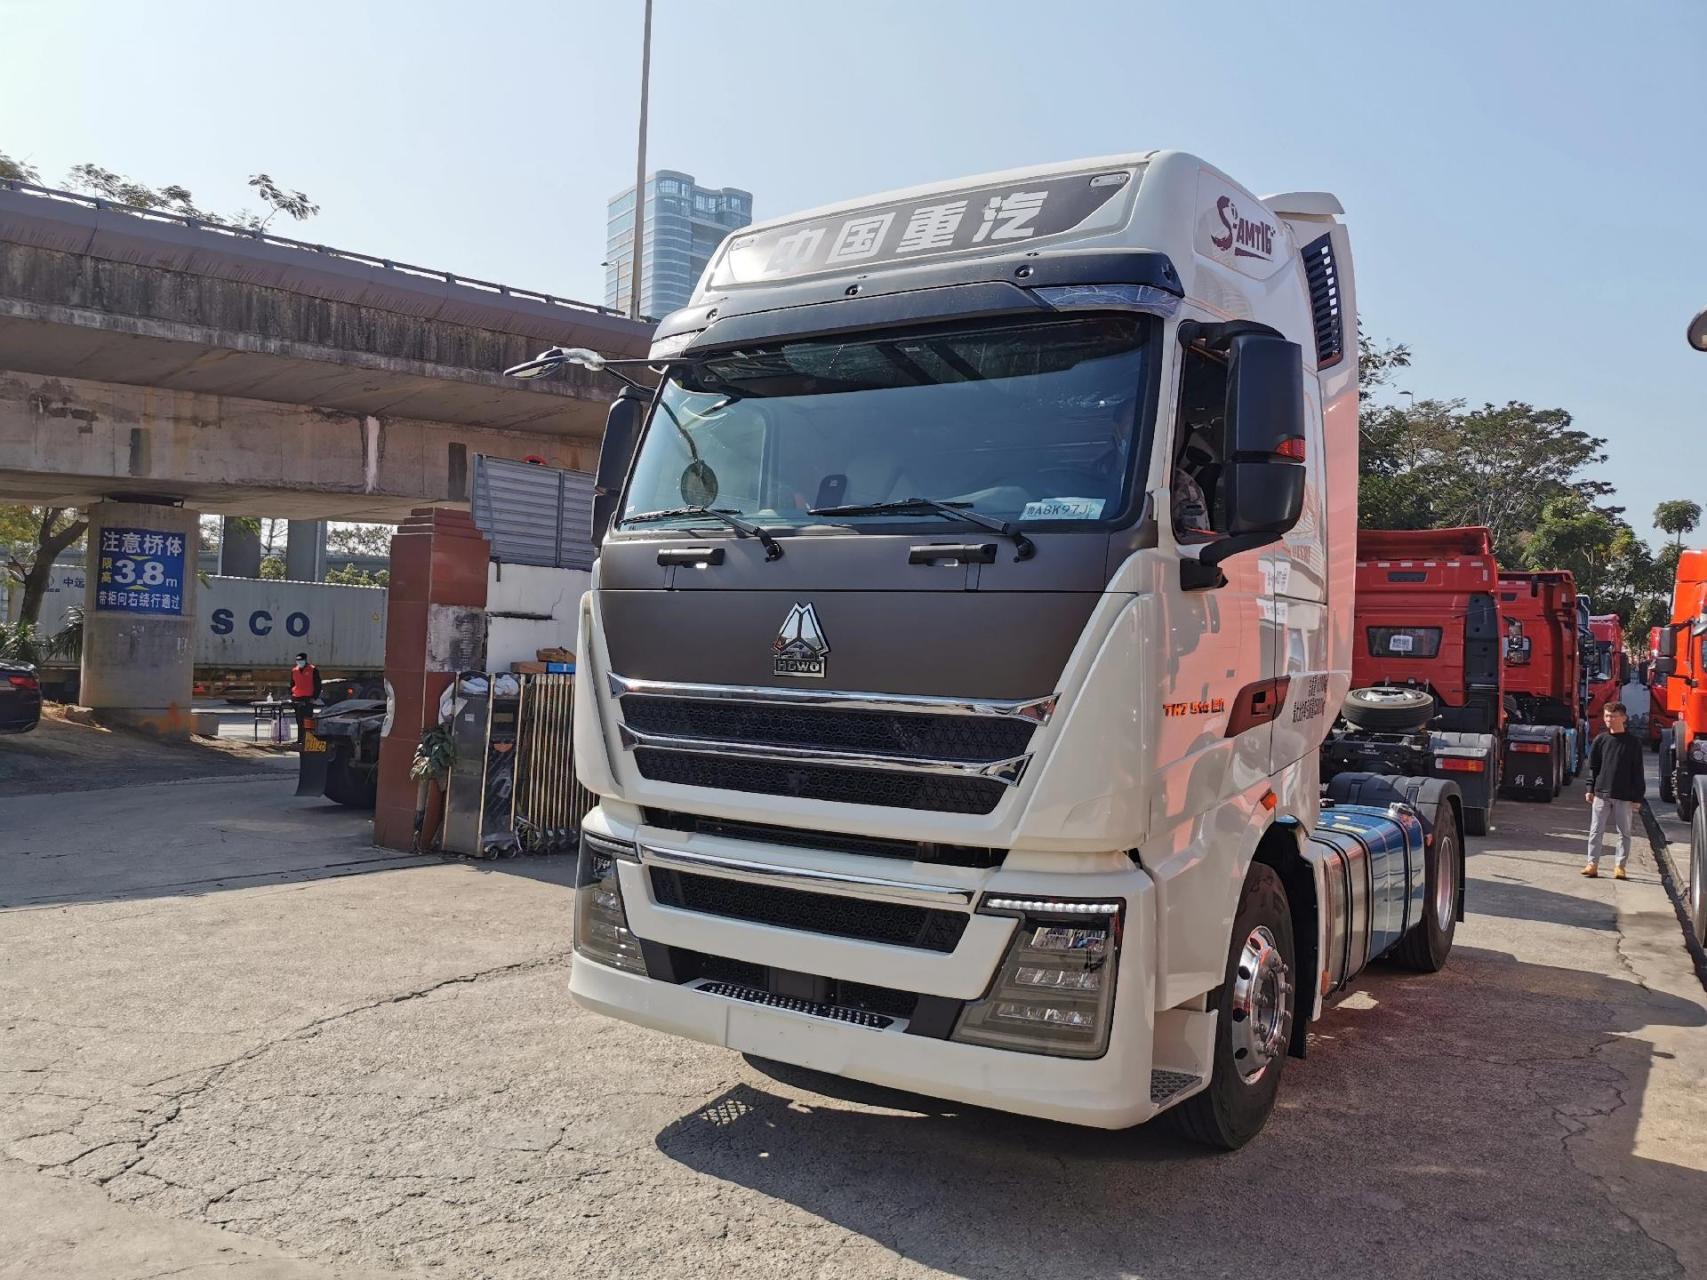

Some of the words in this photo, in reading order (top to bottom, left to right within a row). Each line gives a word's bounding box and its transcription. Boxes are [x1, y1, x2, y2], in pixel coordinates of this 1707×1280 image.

[763, 190, 1050, 273] 中国重汽
[102, 531, 182, 557] 注意桥体
[101, 557, 113, 583] 限高
[99, 591, 180, 610] 带柜向右绕行通过
[777, 660, 820, 671] HOWO
